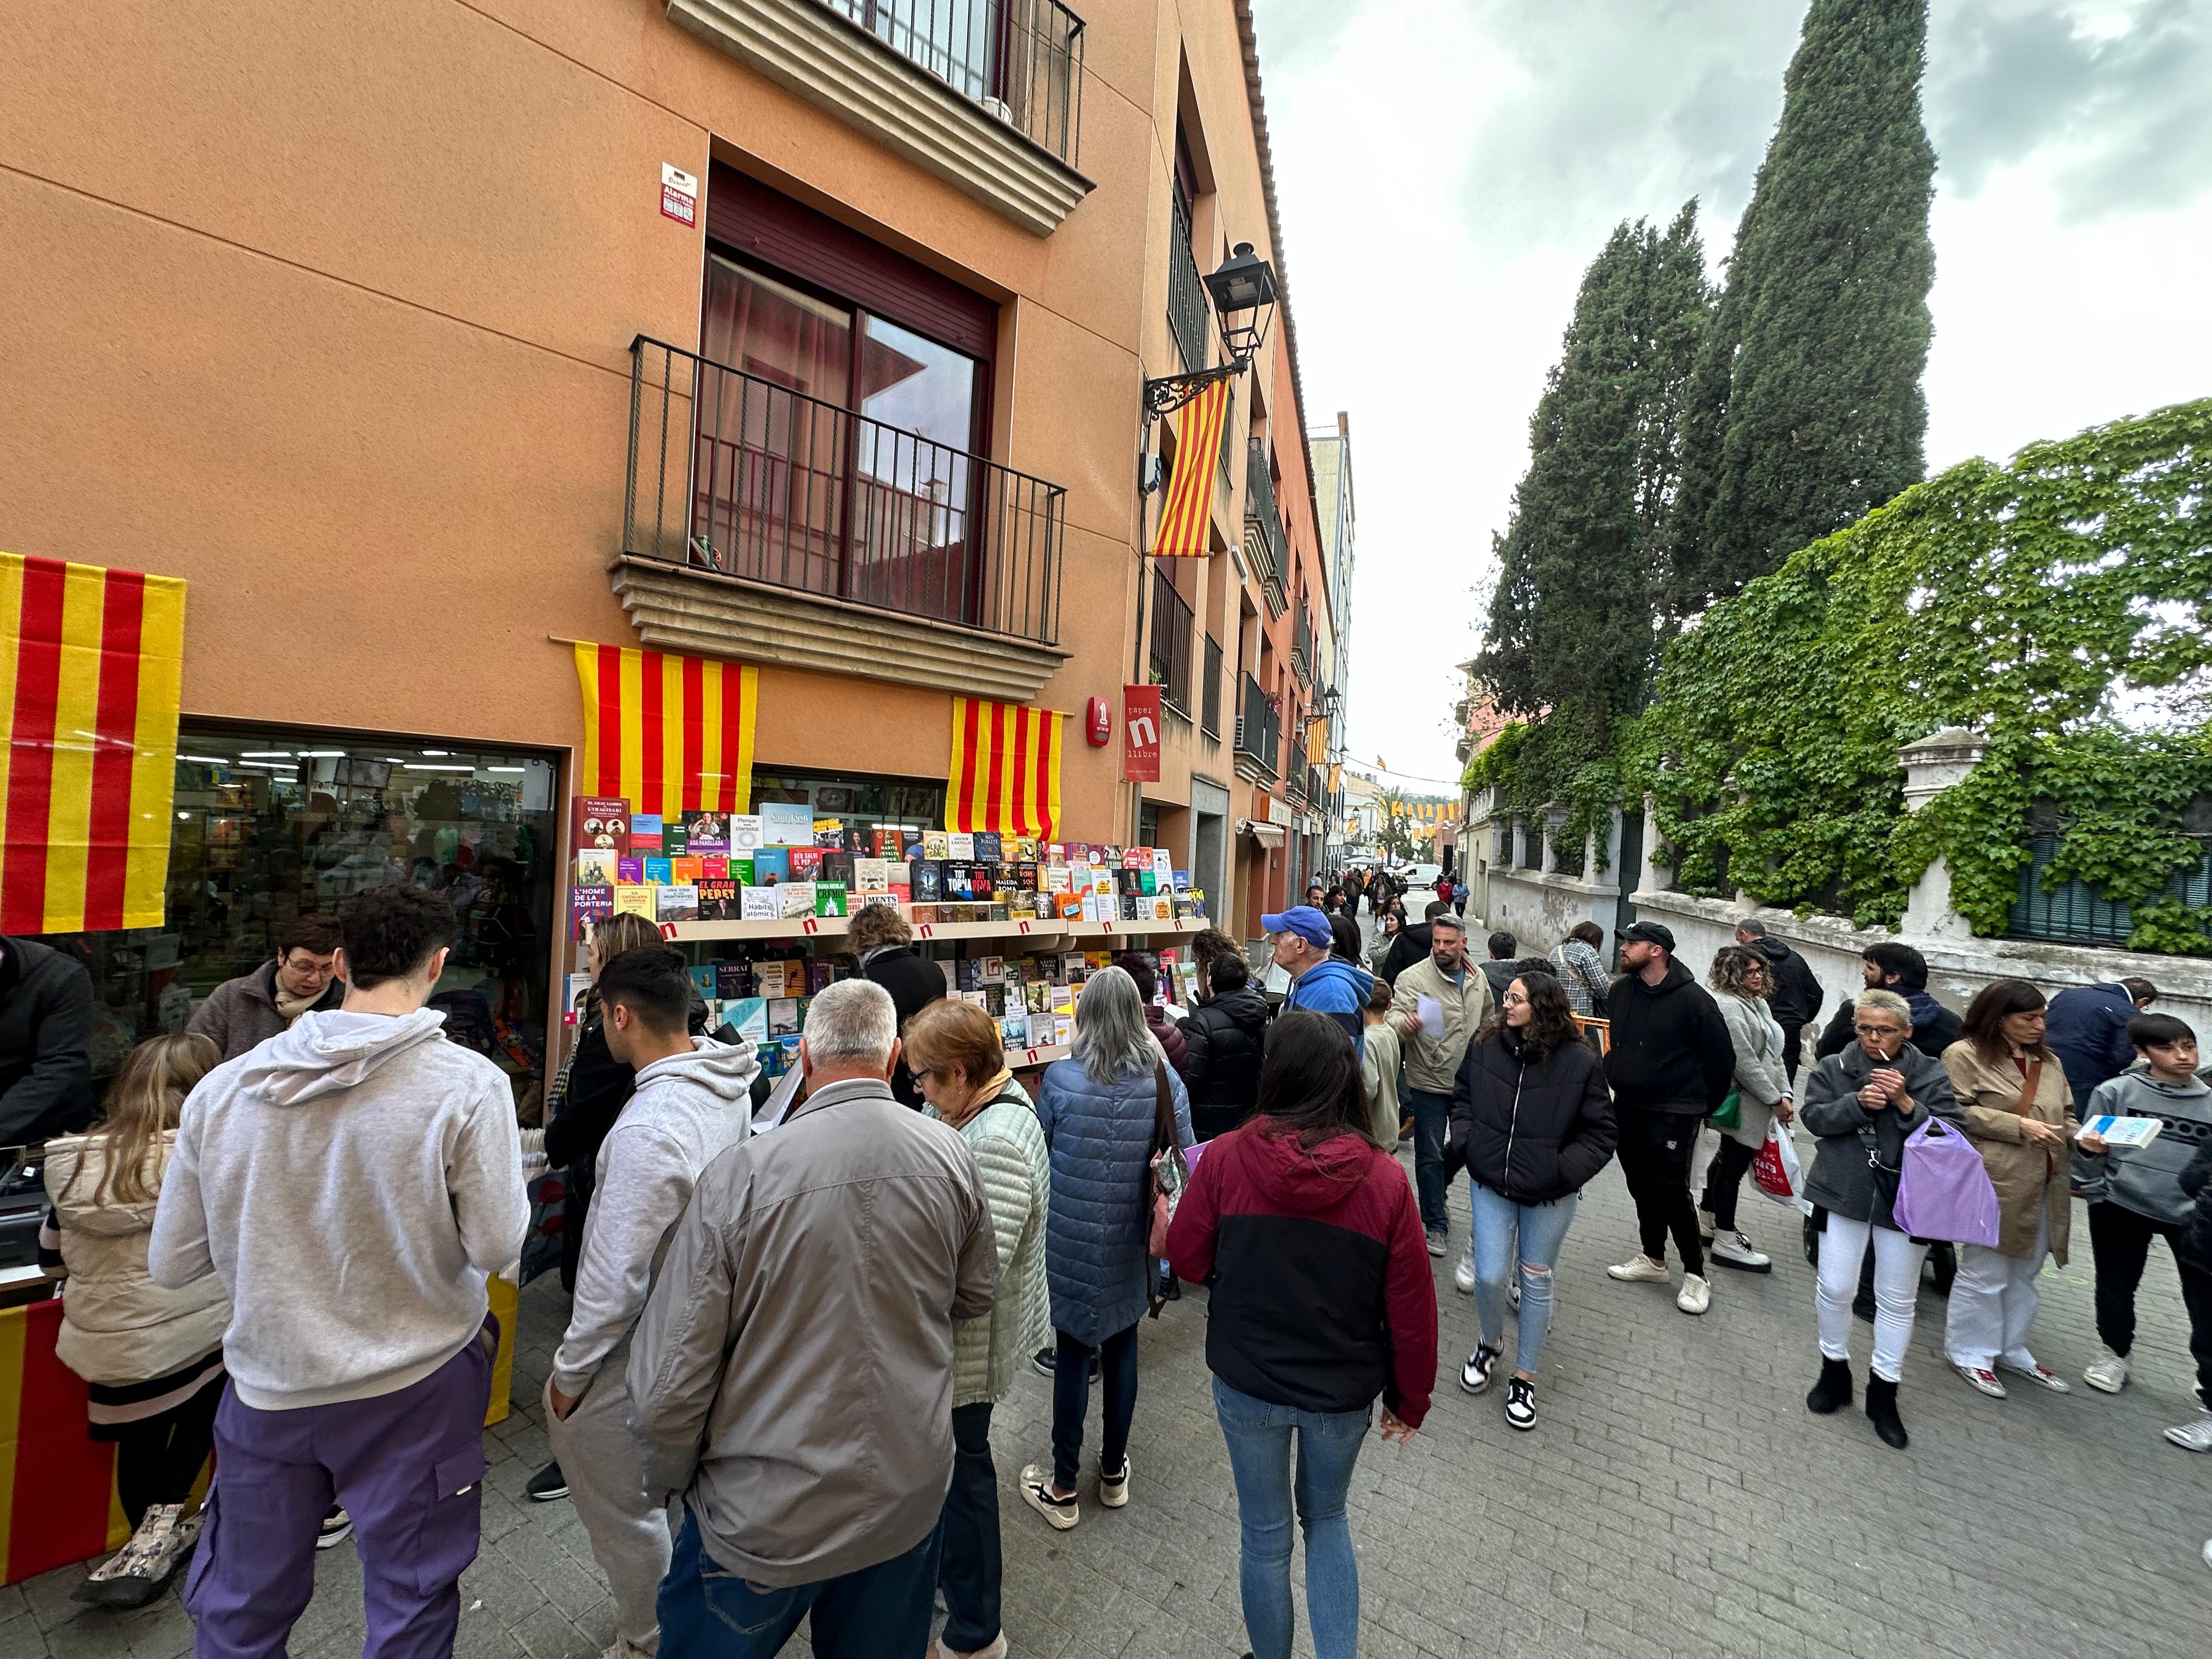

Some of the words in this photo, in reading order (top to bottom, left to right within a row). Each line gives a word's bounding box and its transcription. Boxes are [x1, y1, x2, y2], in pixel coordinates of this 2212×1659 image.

[664, 186, 694, 206] Alarma
[1128, 707, 1153, 715] paper
[1128, 716, 1157, 748] n
[1127, 750, 1157, 758] llibre
[771, 813, 788, 822] Sant
[788, 813, 809, 822] Jordi
[953, 870, 966, 878] TOT
[974, 871, 985, 879] TOT
[698, 881, 709, 889] EL
[710, 881, 736, 889] GRAN
[698, 888, 736, 900] PERET
[817, 888, 845, 899] CREMO!
[659, 922, 678, 940] n
[803, 918, 819, 935] n
[1019, 921, 1030, 934] n
[1102, 921, 1112, 934] n
[1174, 919, 1183, 931] n
[919, 924, 933, 939] n
[719, 964, 749, 973] SERRAT
[1026, 1049, 1039, 1065] n
